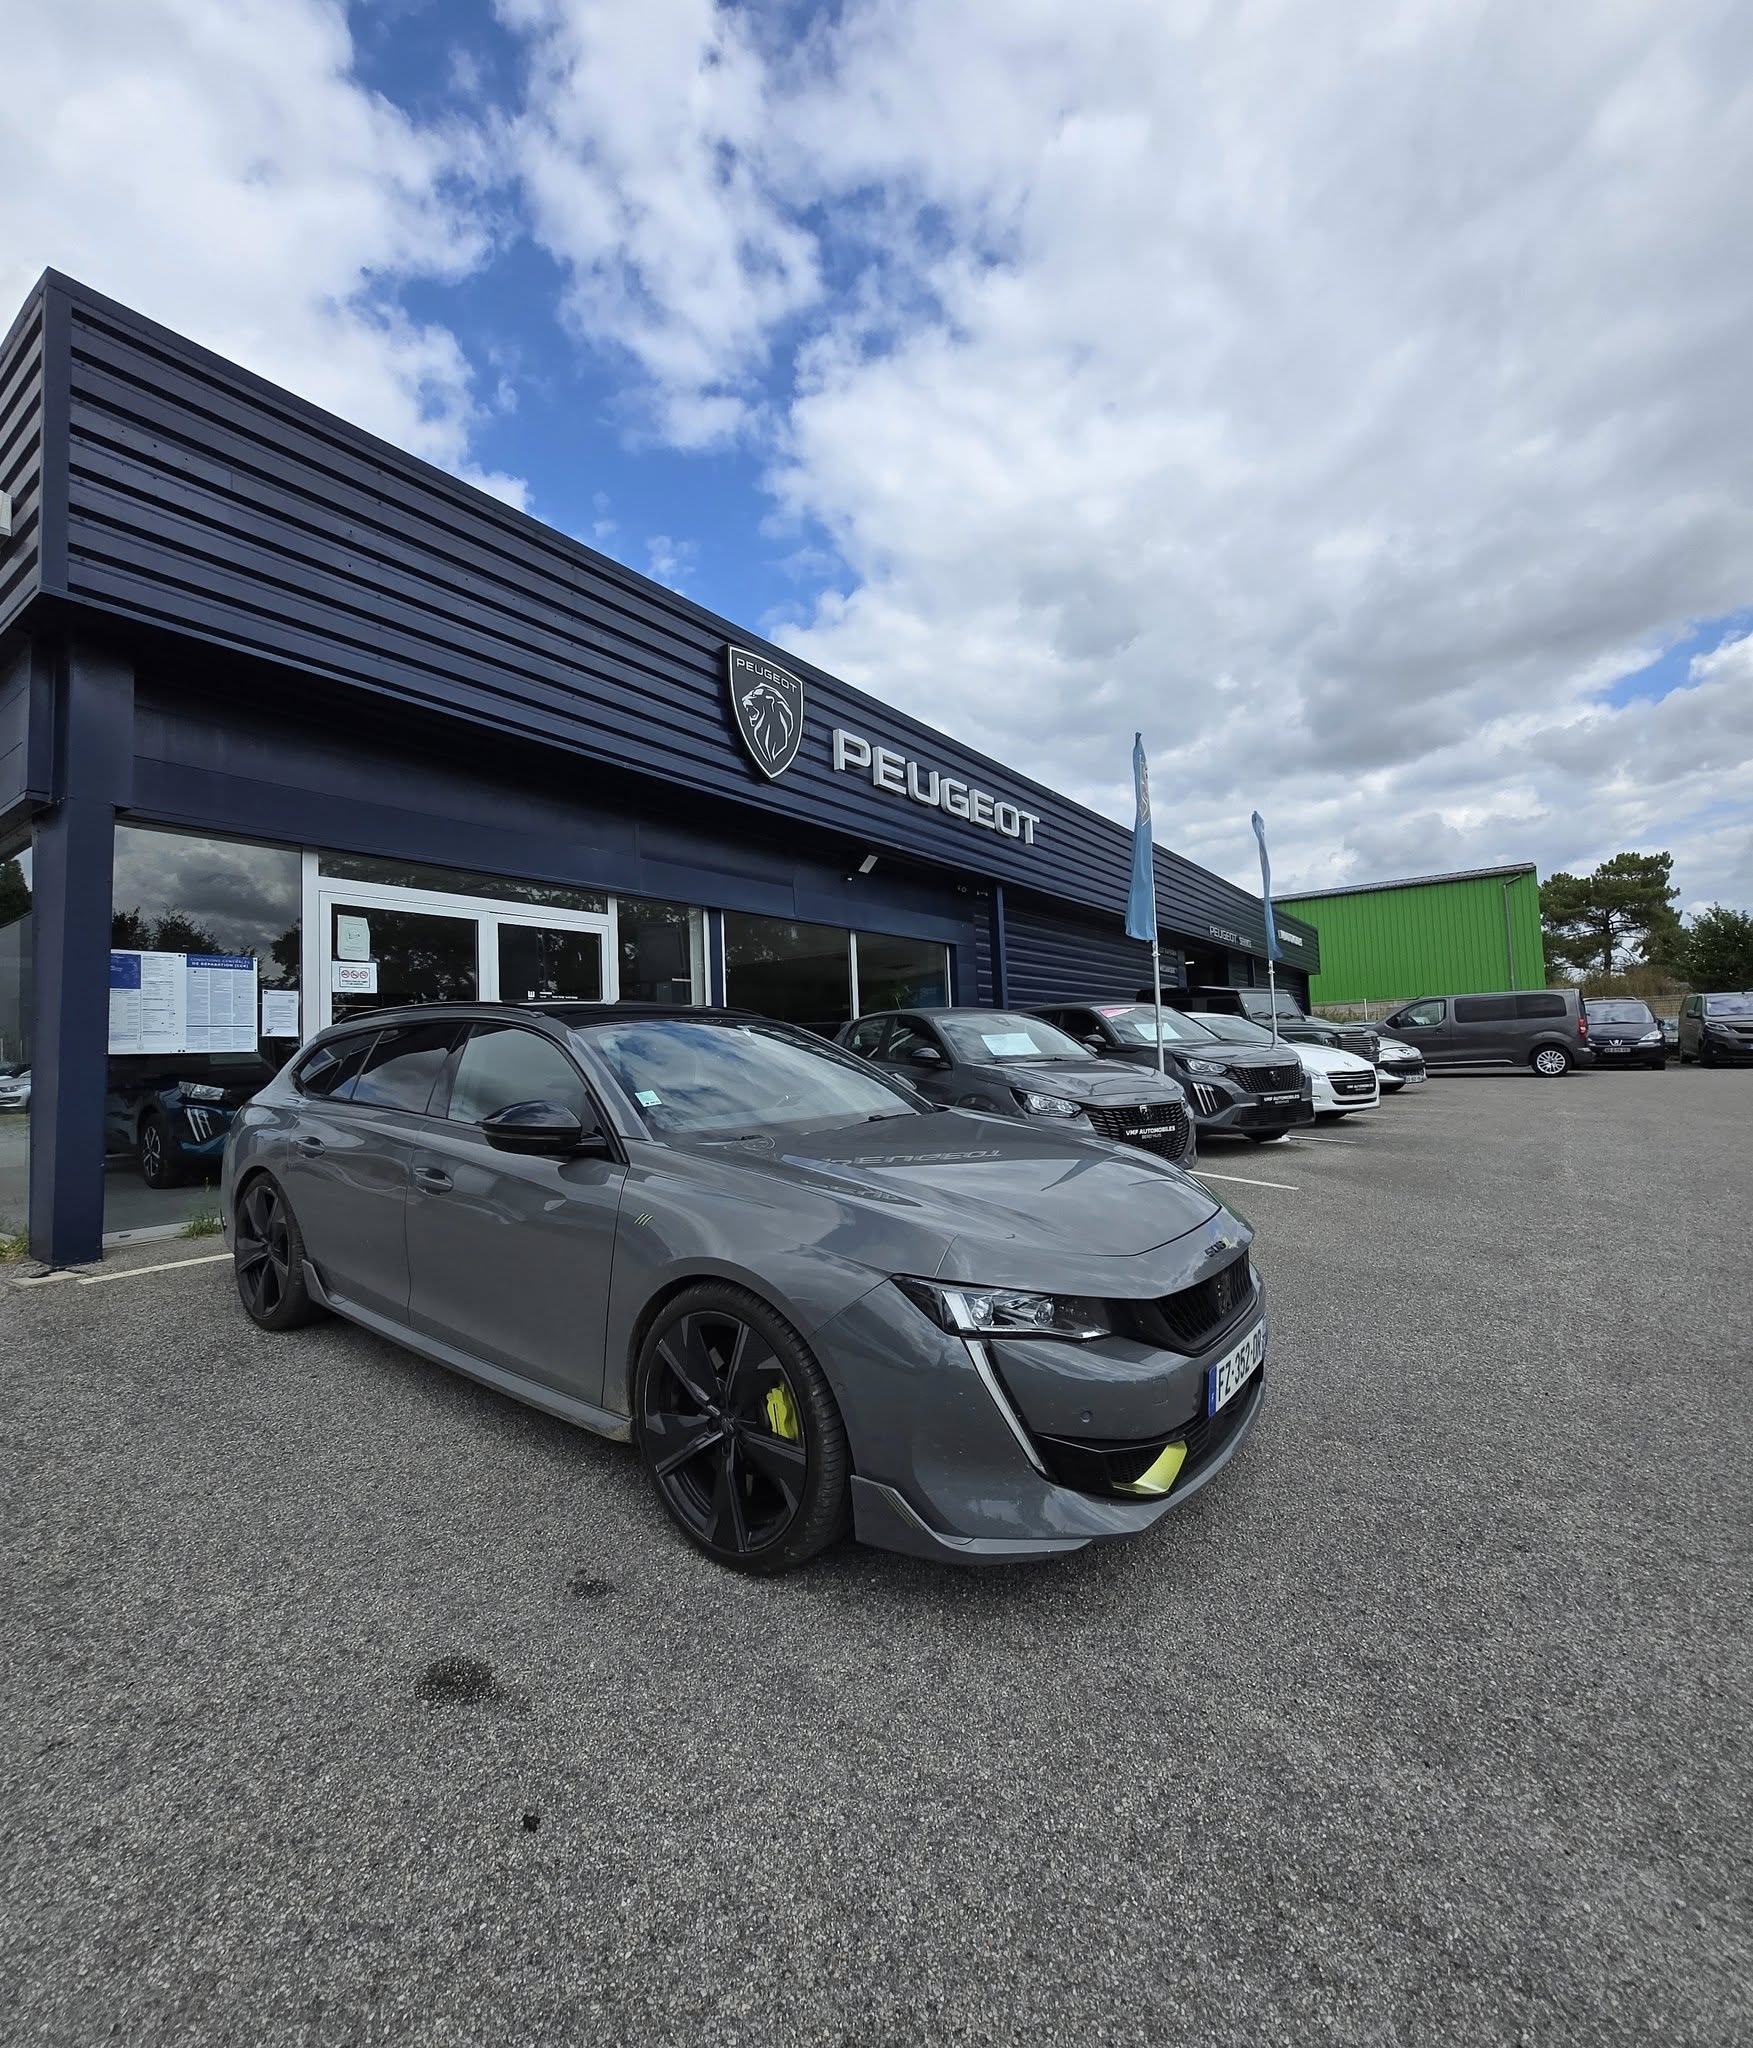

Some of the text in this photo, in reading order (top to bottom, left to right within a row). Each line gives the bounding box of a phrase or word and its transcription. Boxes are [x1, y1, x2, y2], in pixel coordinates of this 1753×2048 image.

[736, 657, 797, 693] PEUGEOT
[832, 728, 1040, 845] PEUGEOT
[1209, 925, 1237, 944] PEUGEOT
[1139, 1125, 1176, 1135] AUTOMOBILES
